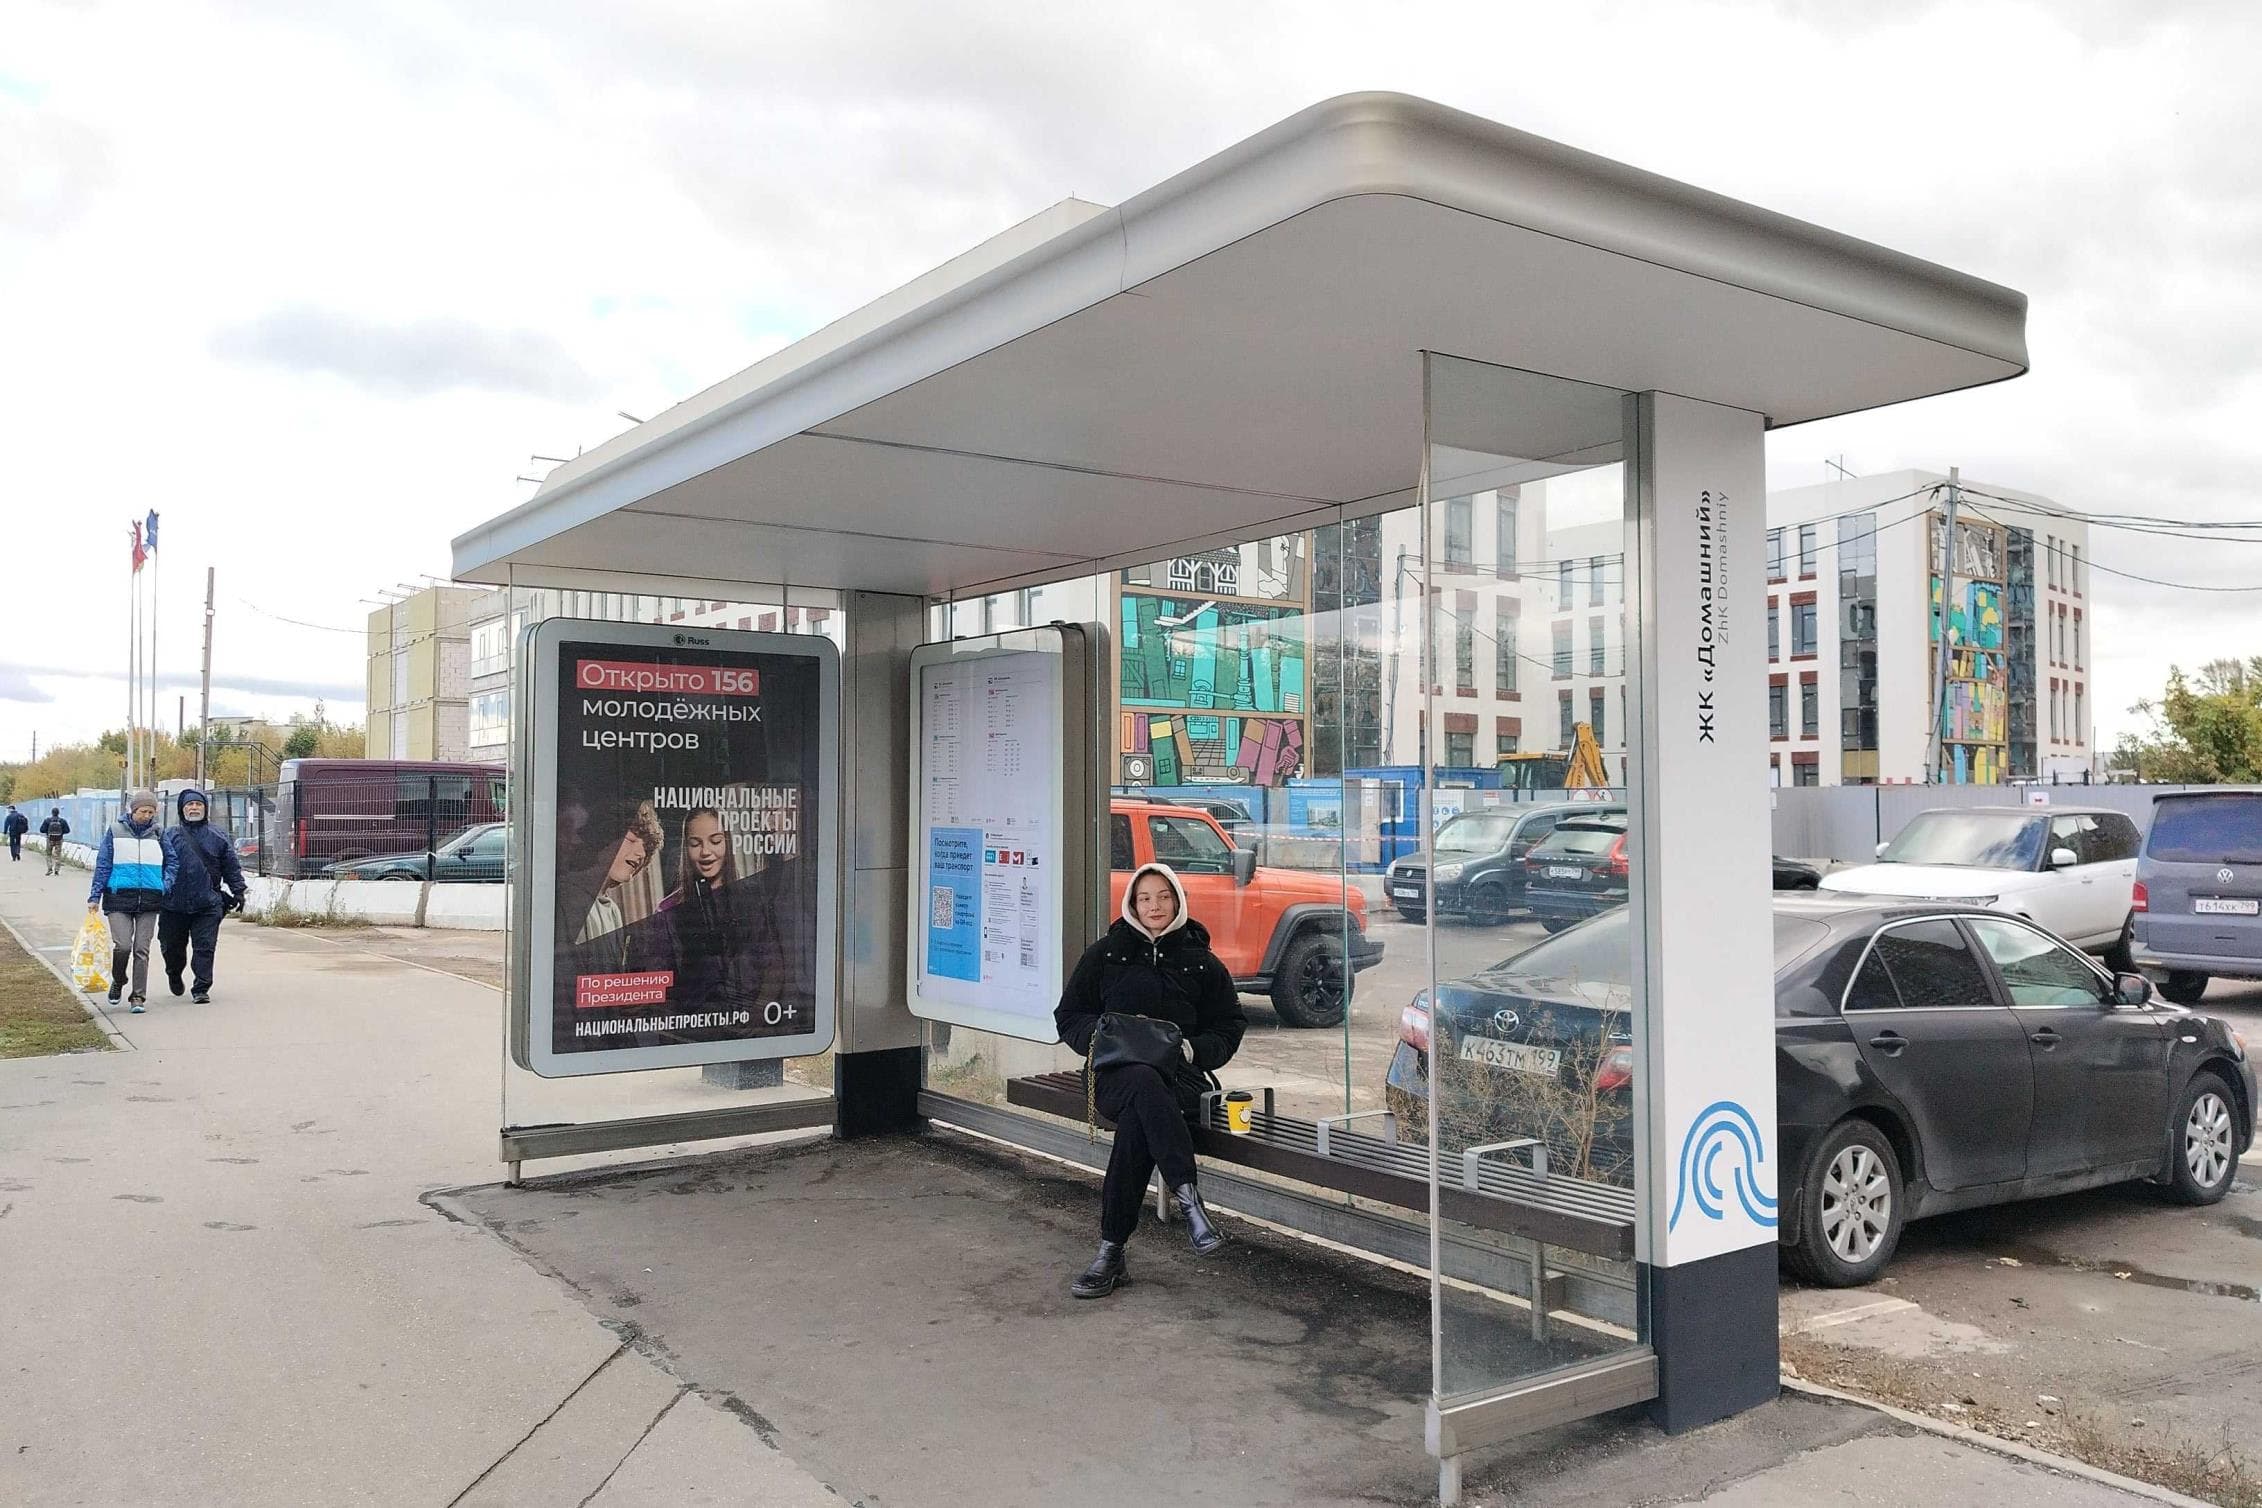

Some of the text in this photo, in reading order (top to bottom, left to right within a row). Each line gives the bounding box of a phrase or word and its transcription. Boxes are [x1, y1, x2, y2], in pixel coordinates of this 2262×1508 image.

[1716, 491, 1729, 645] ZhK Domashniy
[1696, 490, 1716, 744] ЖК «Домашний»
[582, 663, 754, 693] Открыто 156
[583, 698, 762, 722] молодёжных
[582, 729, 699, 753] центров
[654, 787, 797, 811] НАЦИОНАЛЬНЫЕ
[717, 810, 797, 832] ПРОЕКТЫ
[732, 832, 797, 855] РОССИИ
[581, 973, 670, 990] По решению
[581, 989, 664, 1006] Президента
[576, 1001, 797, 1037] НАЦИОНАЛЬНЫЕПРОЕКТЫ.РФ 0+
